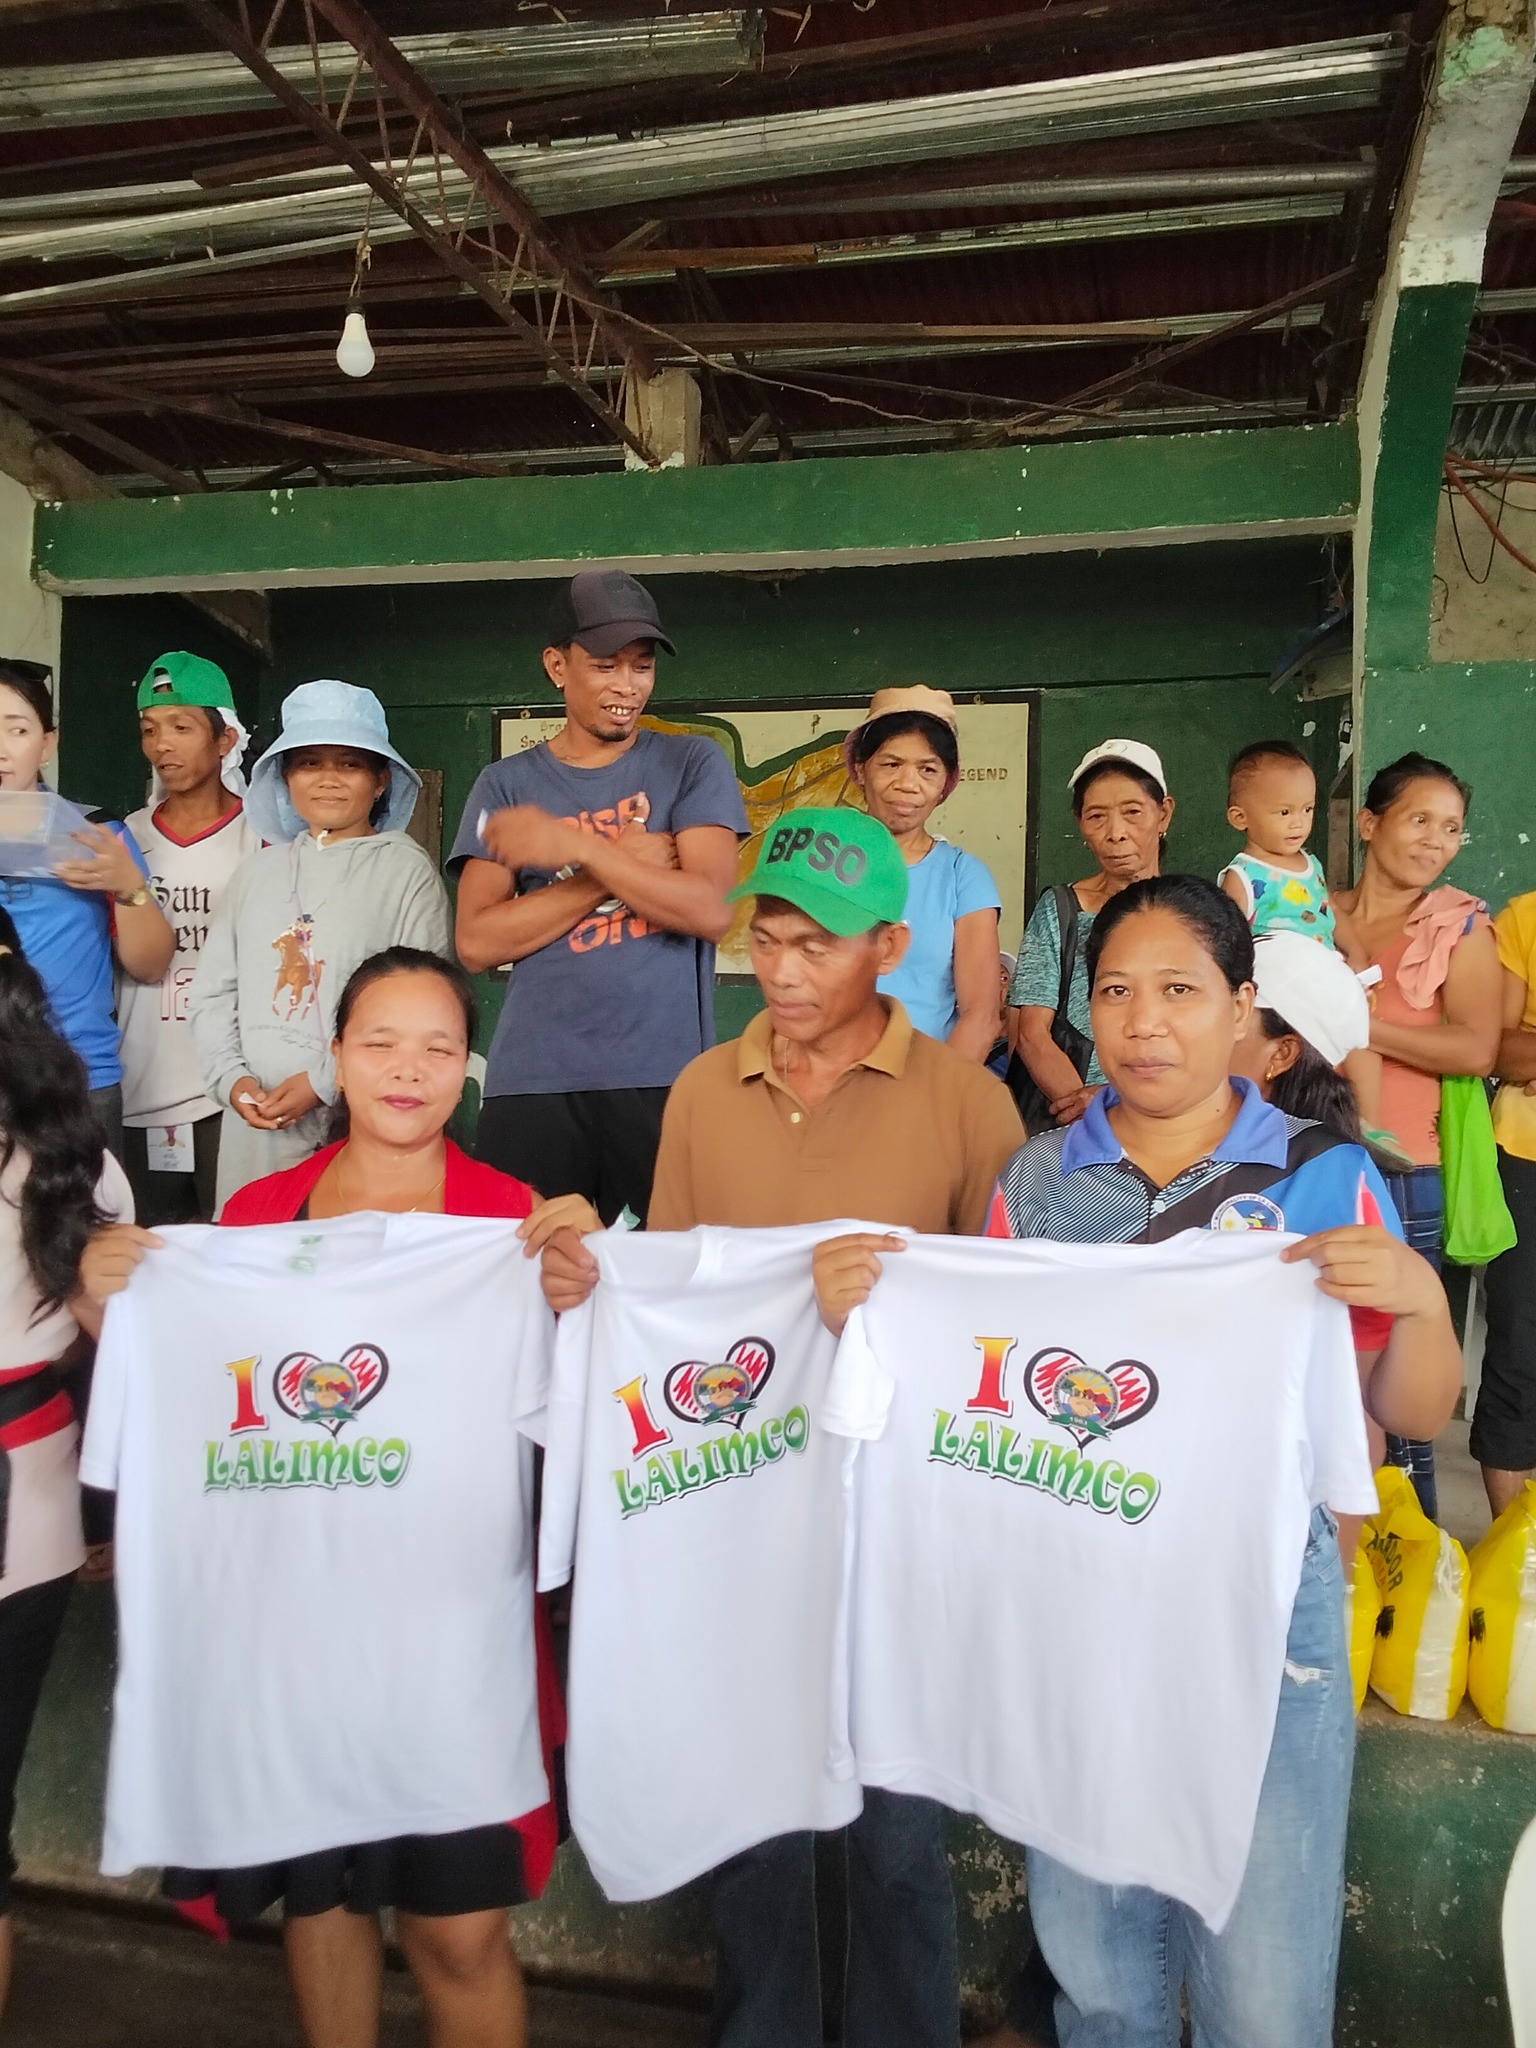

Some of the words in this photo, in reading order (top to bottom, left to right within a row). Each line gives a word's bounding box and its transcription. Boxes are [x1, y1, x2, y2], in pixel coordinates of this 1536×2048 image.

[958, 767, 1008, 782] EGEND
[765, 826, 867, 887] BPSO
[224, 1355, 267, 1433] I
[965, 1336, 1016, 1416] I
[612, 1375, 671, 1458] I
[203, 1436, 408, 1489] LALIMCO
[611, 1403, 809, 1517] LALIMCO
[928, 1407, 1159, 1522] LALIMCO
